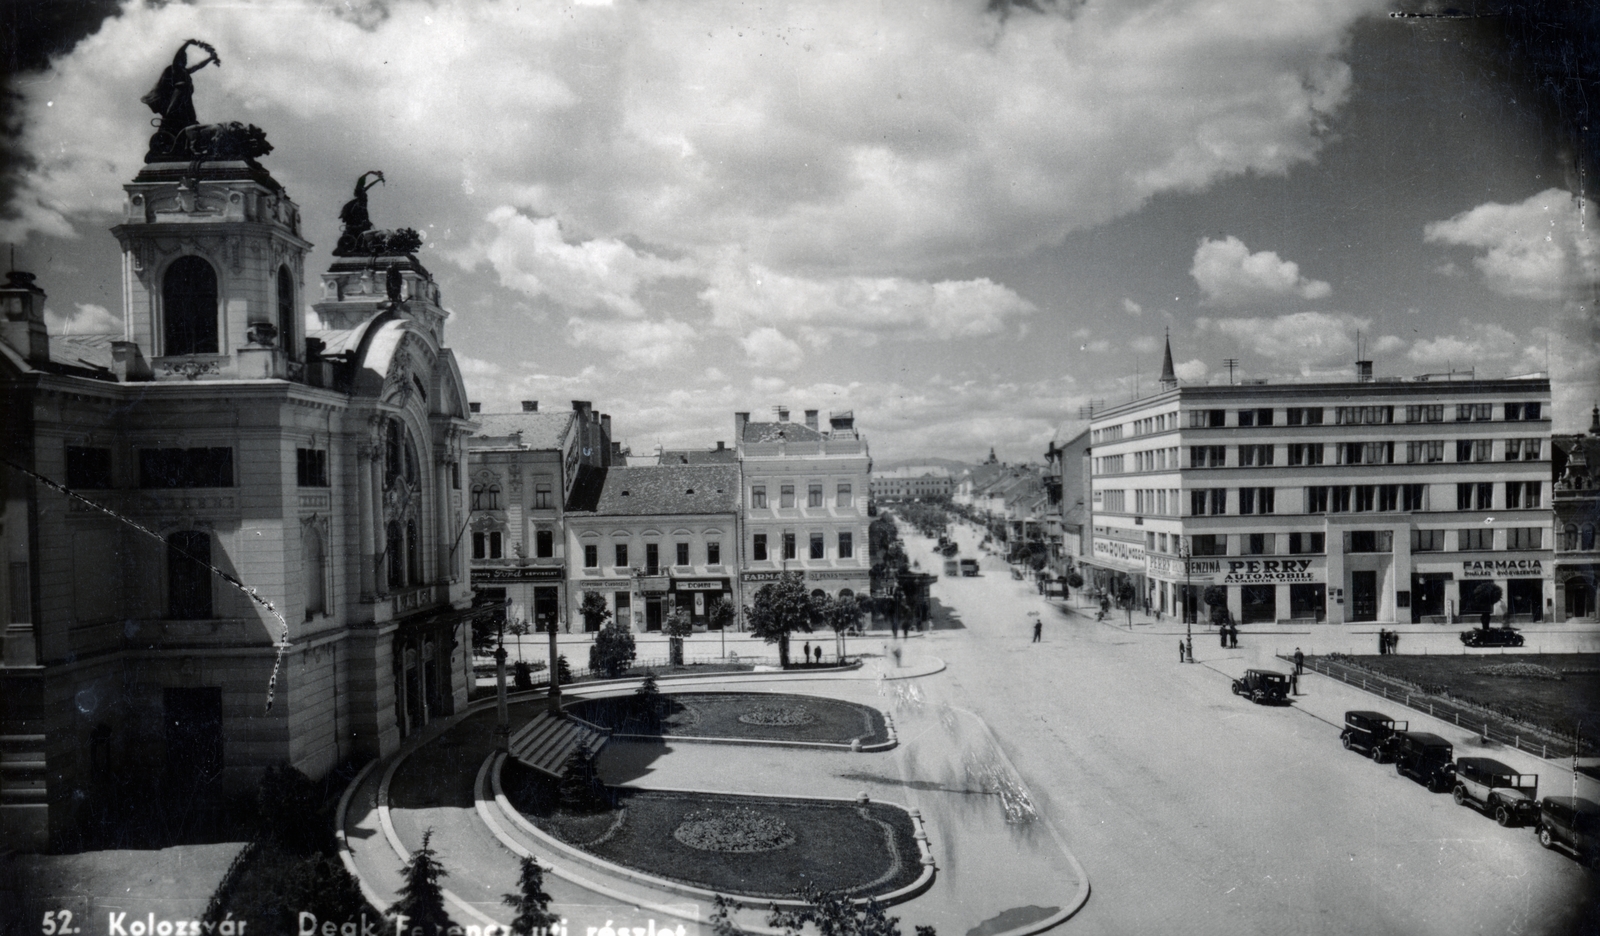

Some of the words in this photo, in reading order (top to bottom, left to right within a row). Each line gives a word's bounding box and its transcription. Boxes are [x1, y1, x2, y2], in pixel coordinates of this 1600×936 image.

[1109, 541, 1129, 560] ROYAL
[1150, 556, 1171, 570] PERRY
[1227, 559, 1313, 574] PERRY
[1463, 560, 1542, 570] FARMACIA
[493, 569, 522, 578] Ford
